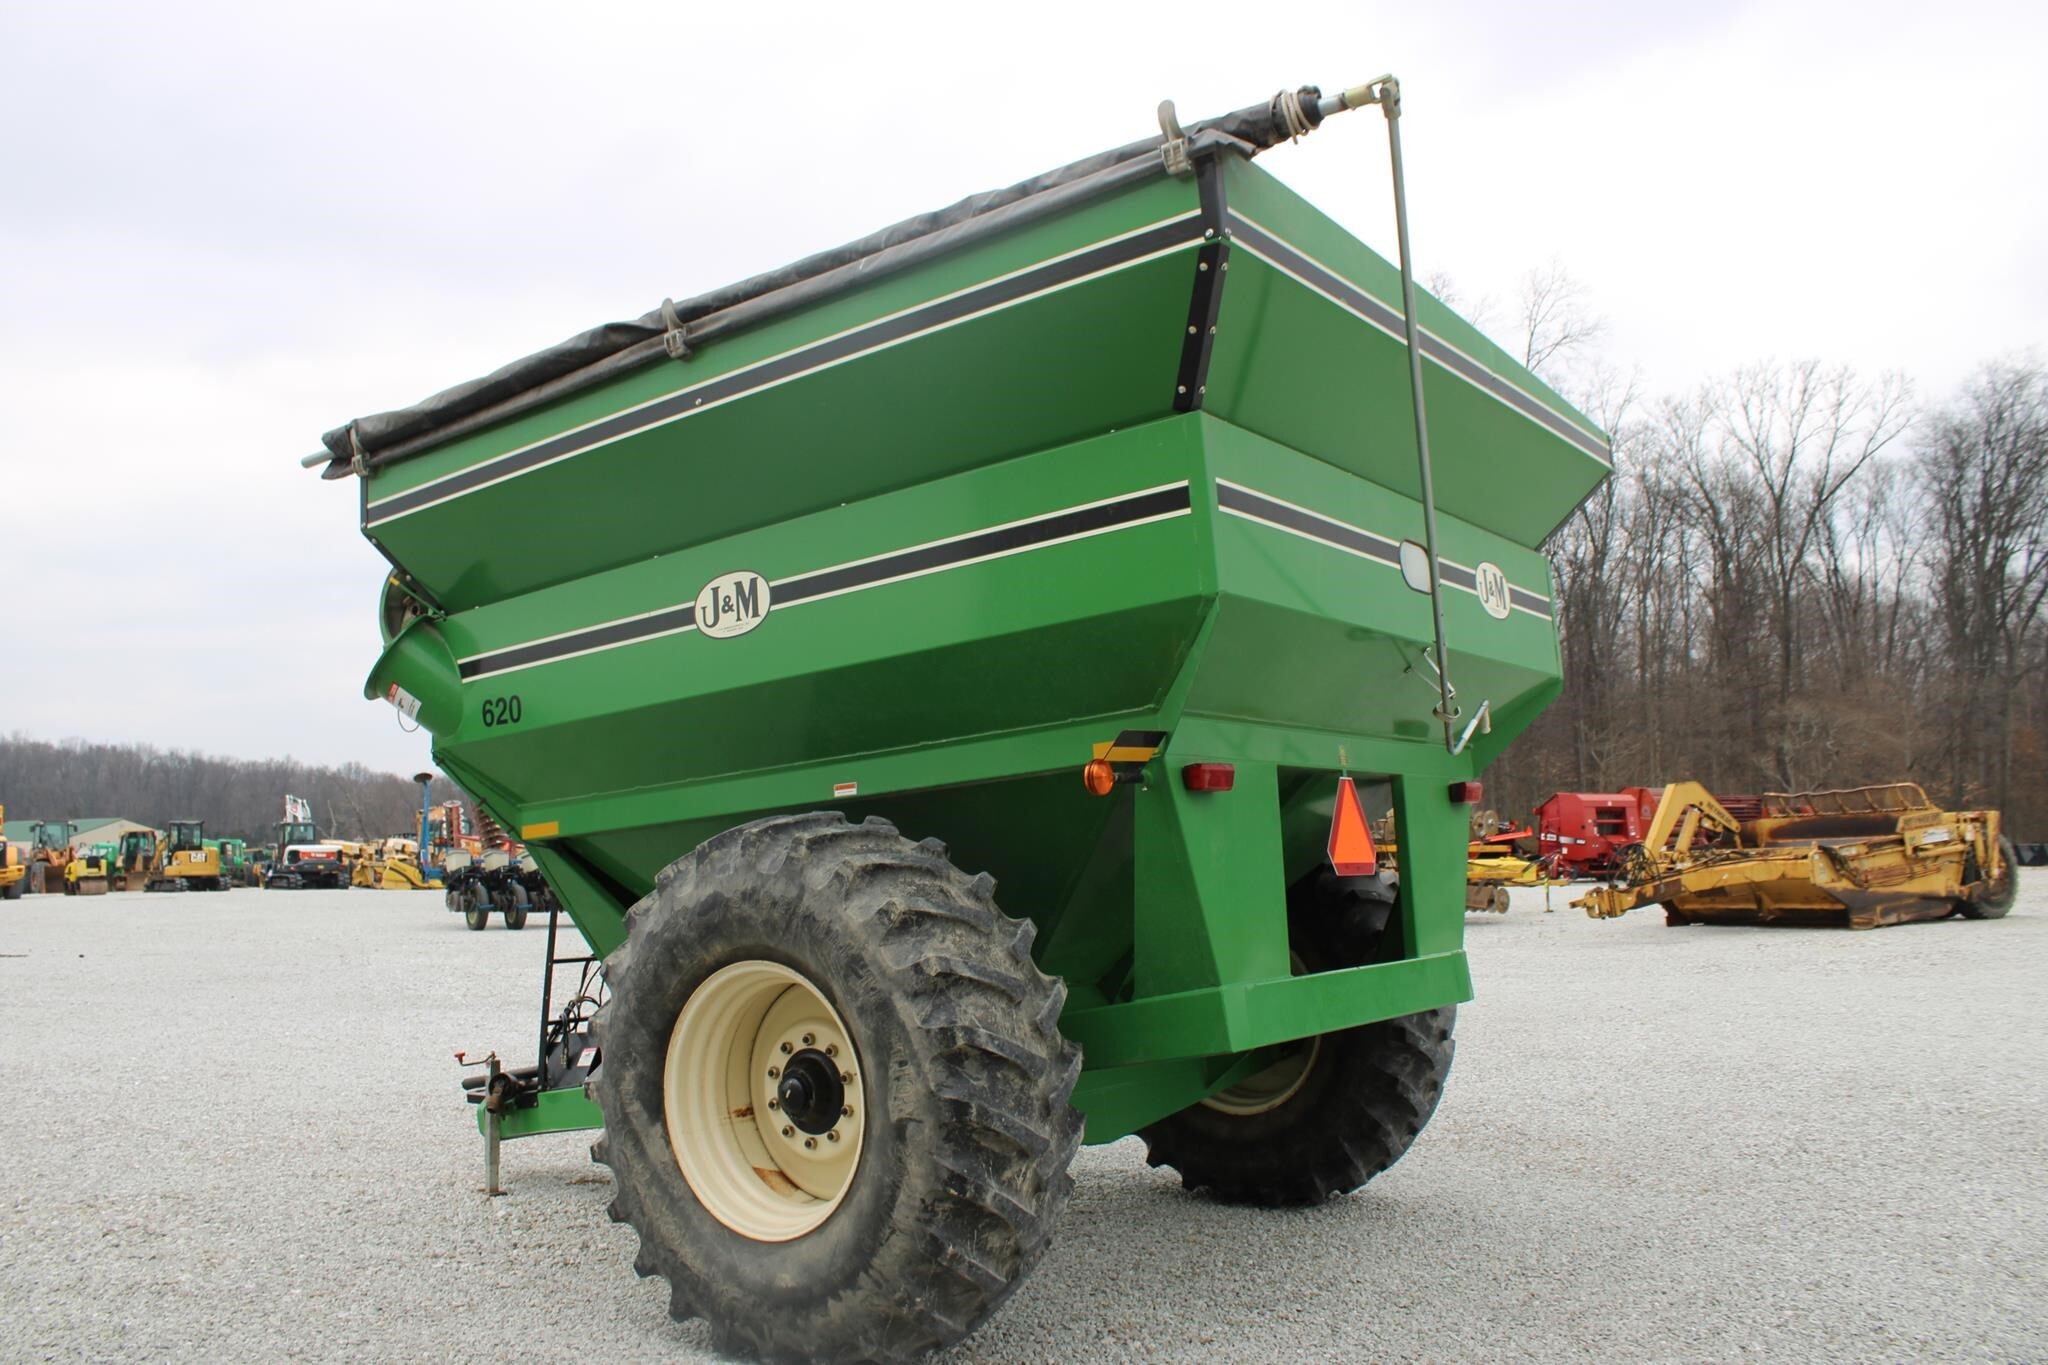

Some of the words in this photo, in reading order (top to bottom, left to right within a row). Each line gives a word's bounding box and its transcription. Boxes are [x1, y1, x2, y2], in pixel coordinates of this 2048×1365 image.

[701, 576, 761, 629] J&M
[1479, 568, 1508, 609] J&M
[482, 695, 522, 727] 620
